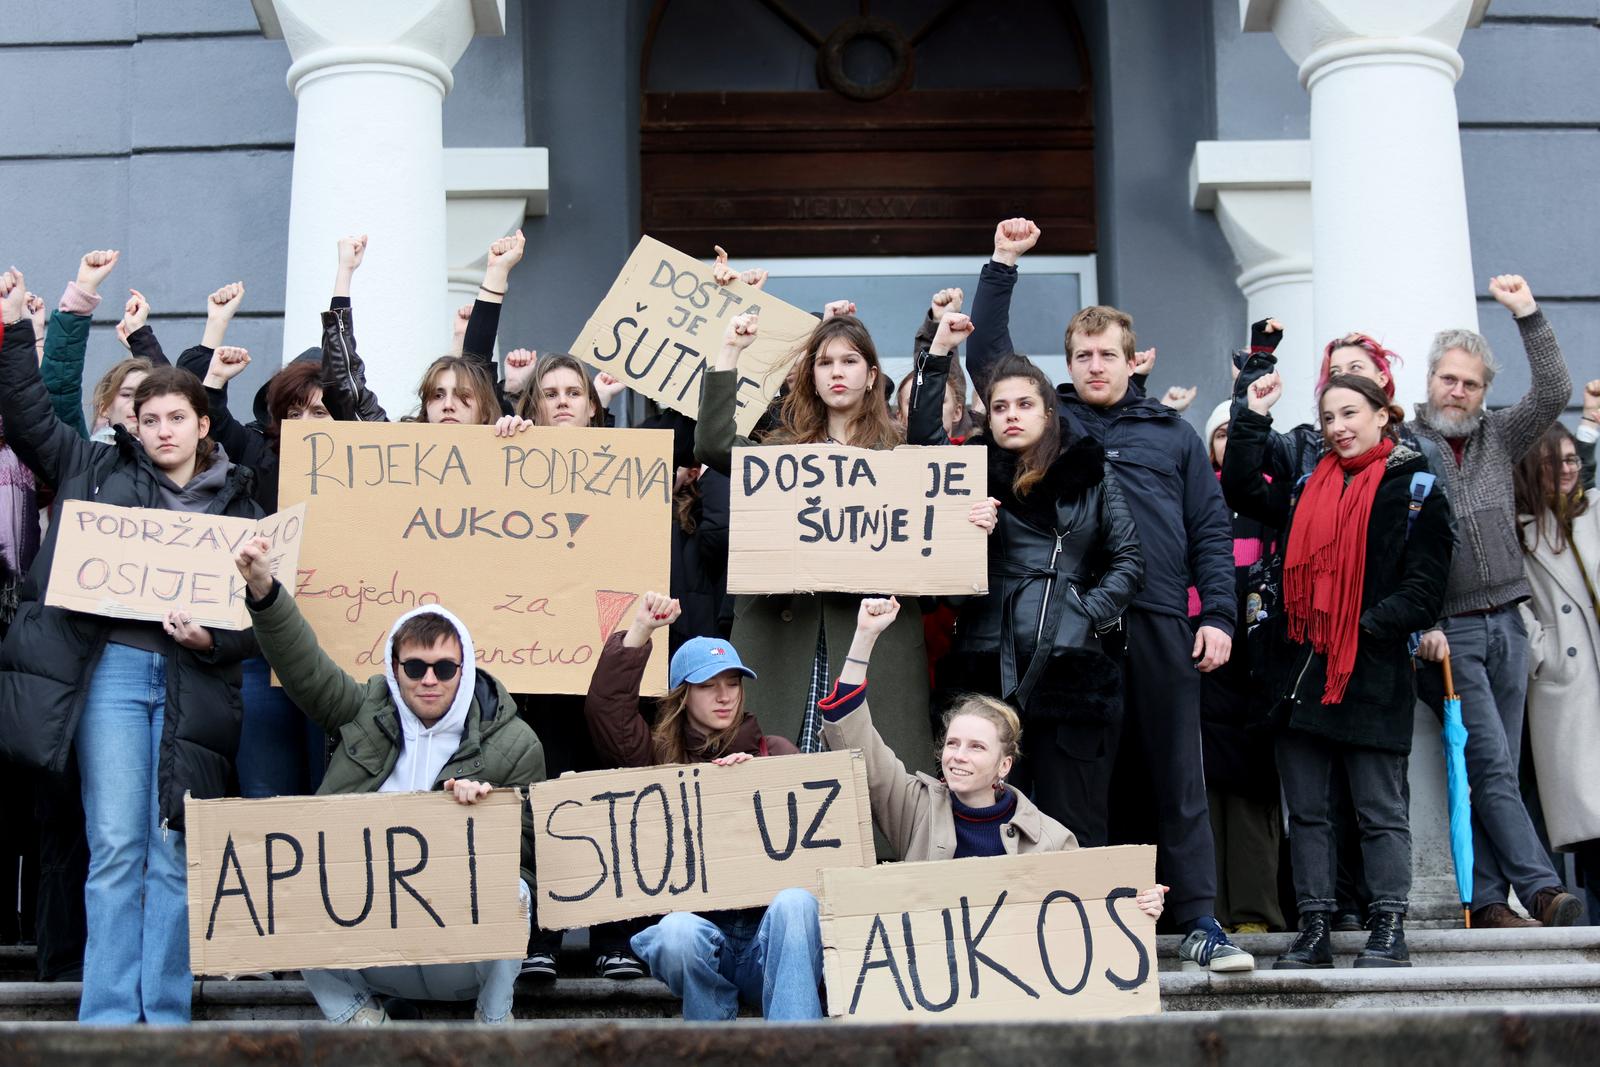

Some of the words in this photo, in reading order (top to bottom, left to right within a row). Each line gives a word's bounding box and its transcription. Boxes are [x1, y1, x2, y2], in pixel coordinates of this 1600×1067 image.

[667, 305, 707, 336] JE
[303, 432, 471, 495] RIJEKA
[501, 444, 670, 503] PODRŽAVA
[743, 454, 876, 496] DOSTA
[925, 462, 971, 498] JE
[76, 511, 299, 553] PODRŽAVMO
[77, 557, 247, 608] OSIJEK
[493, 593, 555, 617] za
[753, 779, 841, 861] UZ
[206, 817, 479, 940] APURI
[849, 887, 1150, 1014] AUKOS
